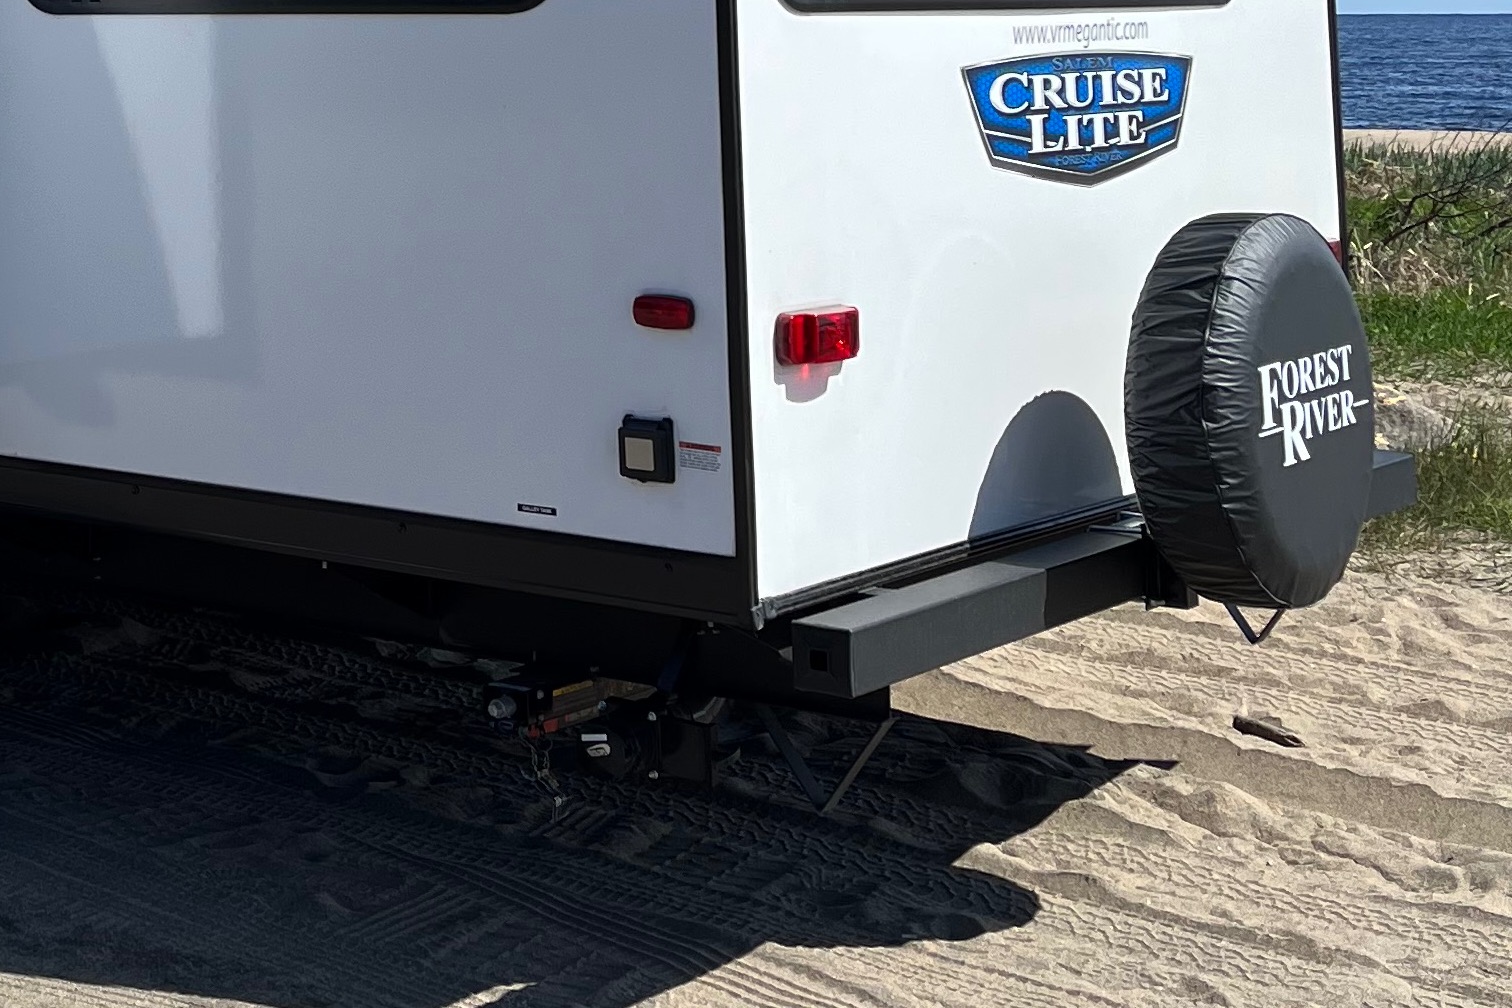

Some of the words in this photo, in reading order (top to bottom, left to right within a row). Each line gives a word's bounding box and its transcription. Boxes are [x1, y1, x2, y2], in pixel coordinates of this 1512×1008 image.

[1012, 17, 1149, 49] www.vrmegantic.com
[1051, 56, 1114, 71] SALEM
[989, 67, 1170, 114] CRUISE
[1025, 110, 1147, 155] LITE
[1257, 344, 1352, 429] FOREST
[1277, 389, 1358, 467] RIVER
